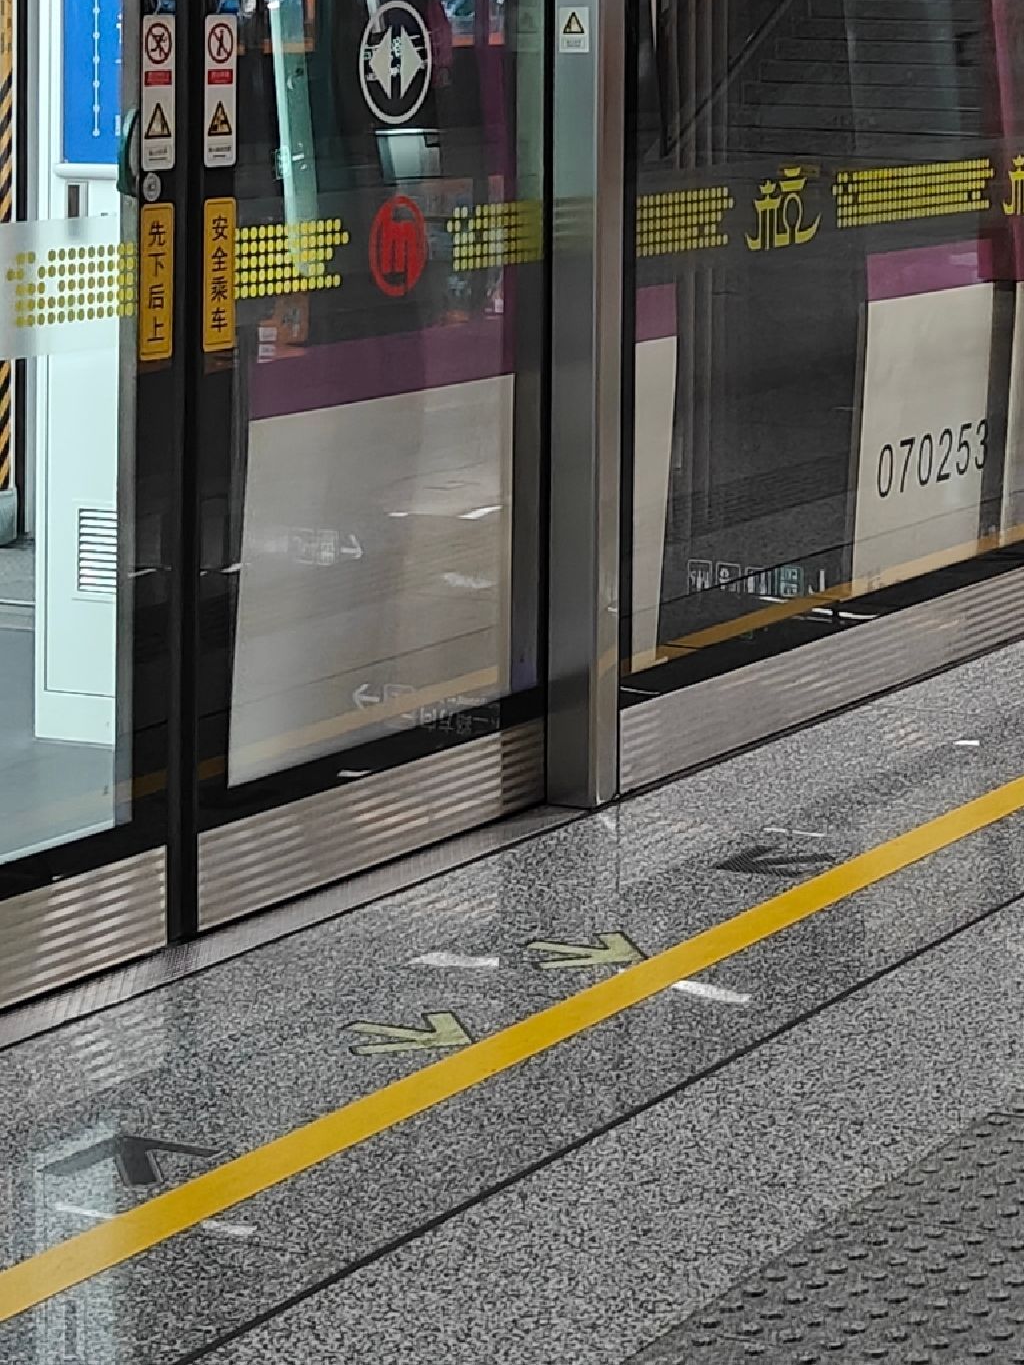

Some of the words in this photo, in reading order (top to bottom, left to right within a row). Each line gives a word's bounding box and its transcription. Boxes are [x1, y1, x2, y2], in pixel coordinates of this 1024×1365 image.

[148, 223, 166, 342] 先下后上
[210, 214, 229, 333] 安全乘车
[877, 418, 990, 498] 070253
